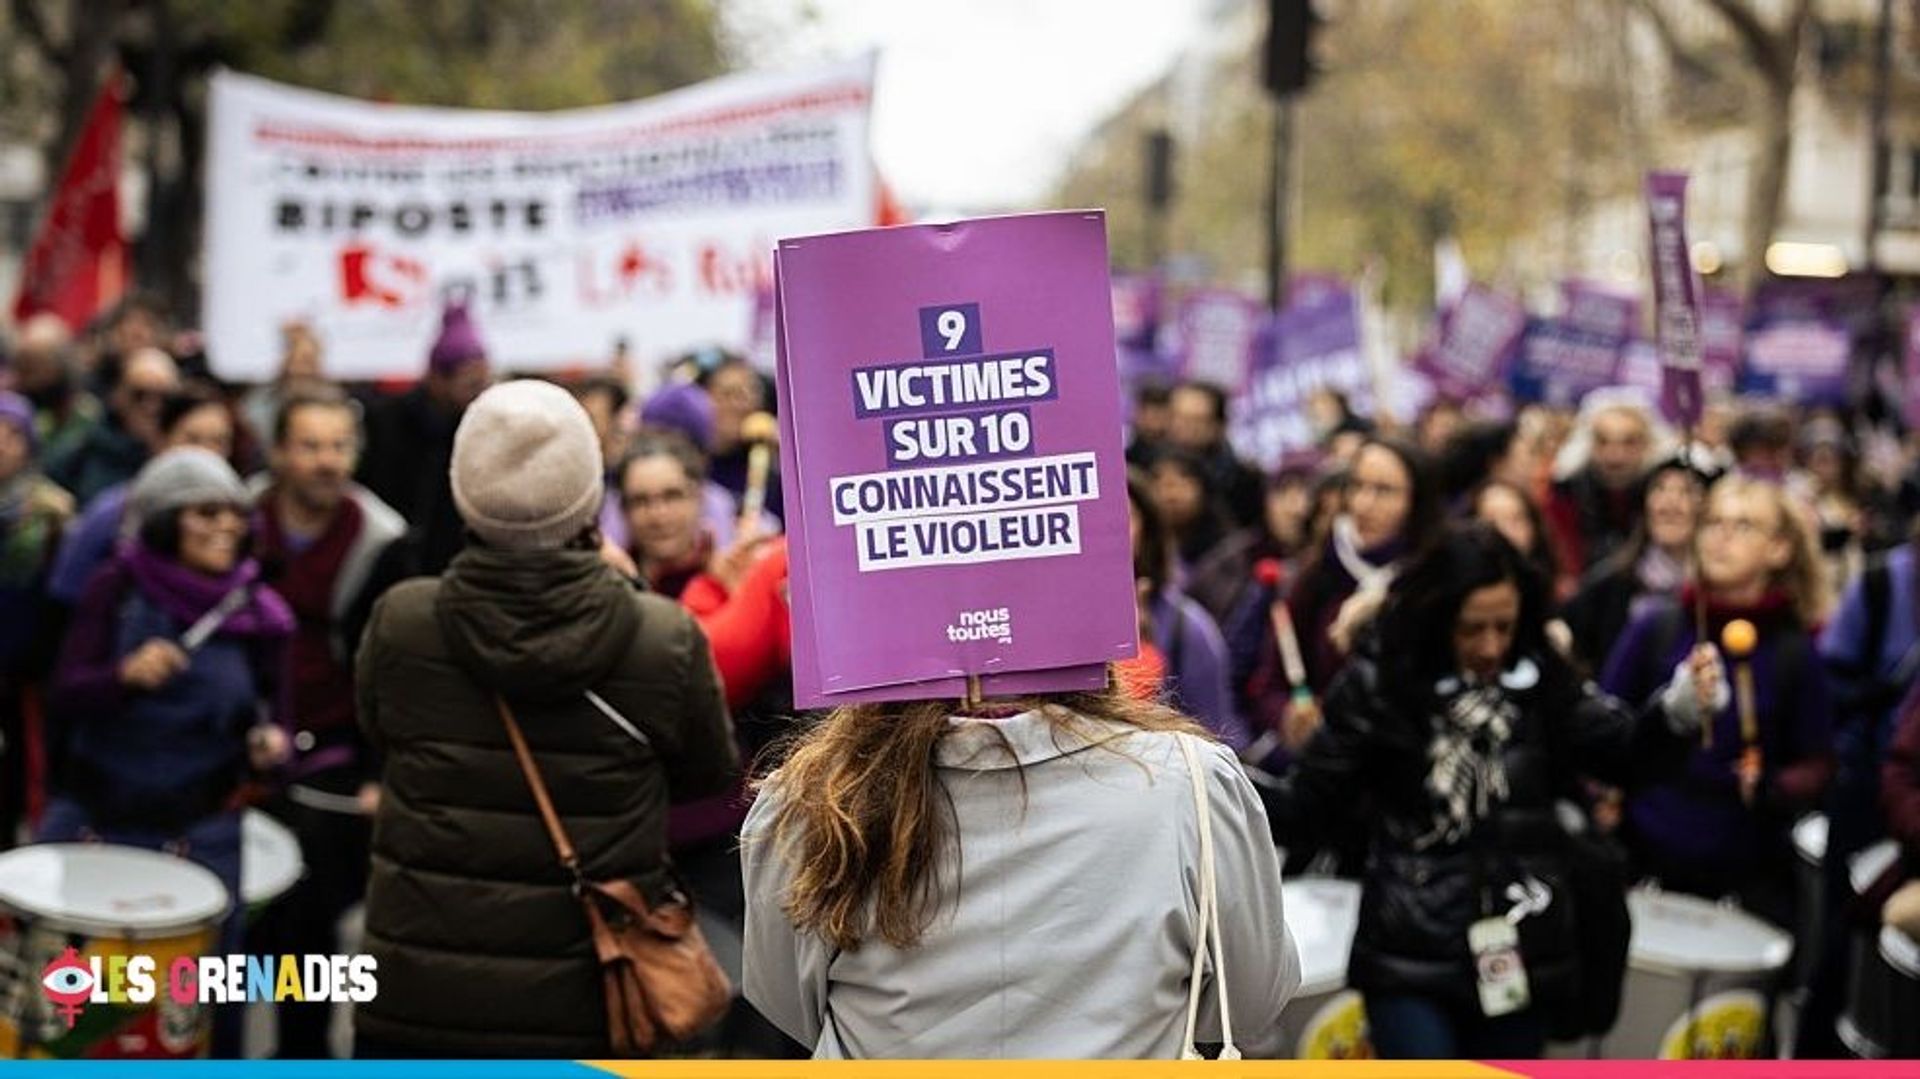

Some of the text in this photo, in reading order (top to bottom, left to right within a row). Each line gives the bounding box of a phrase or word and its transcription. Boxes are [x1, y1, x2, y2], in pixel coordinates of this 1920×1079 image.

[274, 202, 548, 240] RIPOSTE
[938, 311, 966, 350] 9
[856, 356, 1051, 410] VICTIMES
[892, 412, 1030, 461] SUR 10
[835, 461, 1094, 516] CONNAISSENT
[866, 512, 1072, 561] LE VIOLEUR
[946, 623, 1011, 642] toutes
[960, 608, 1010, 626] nous
